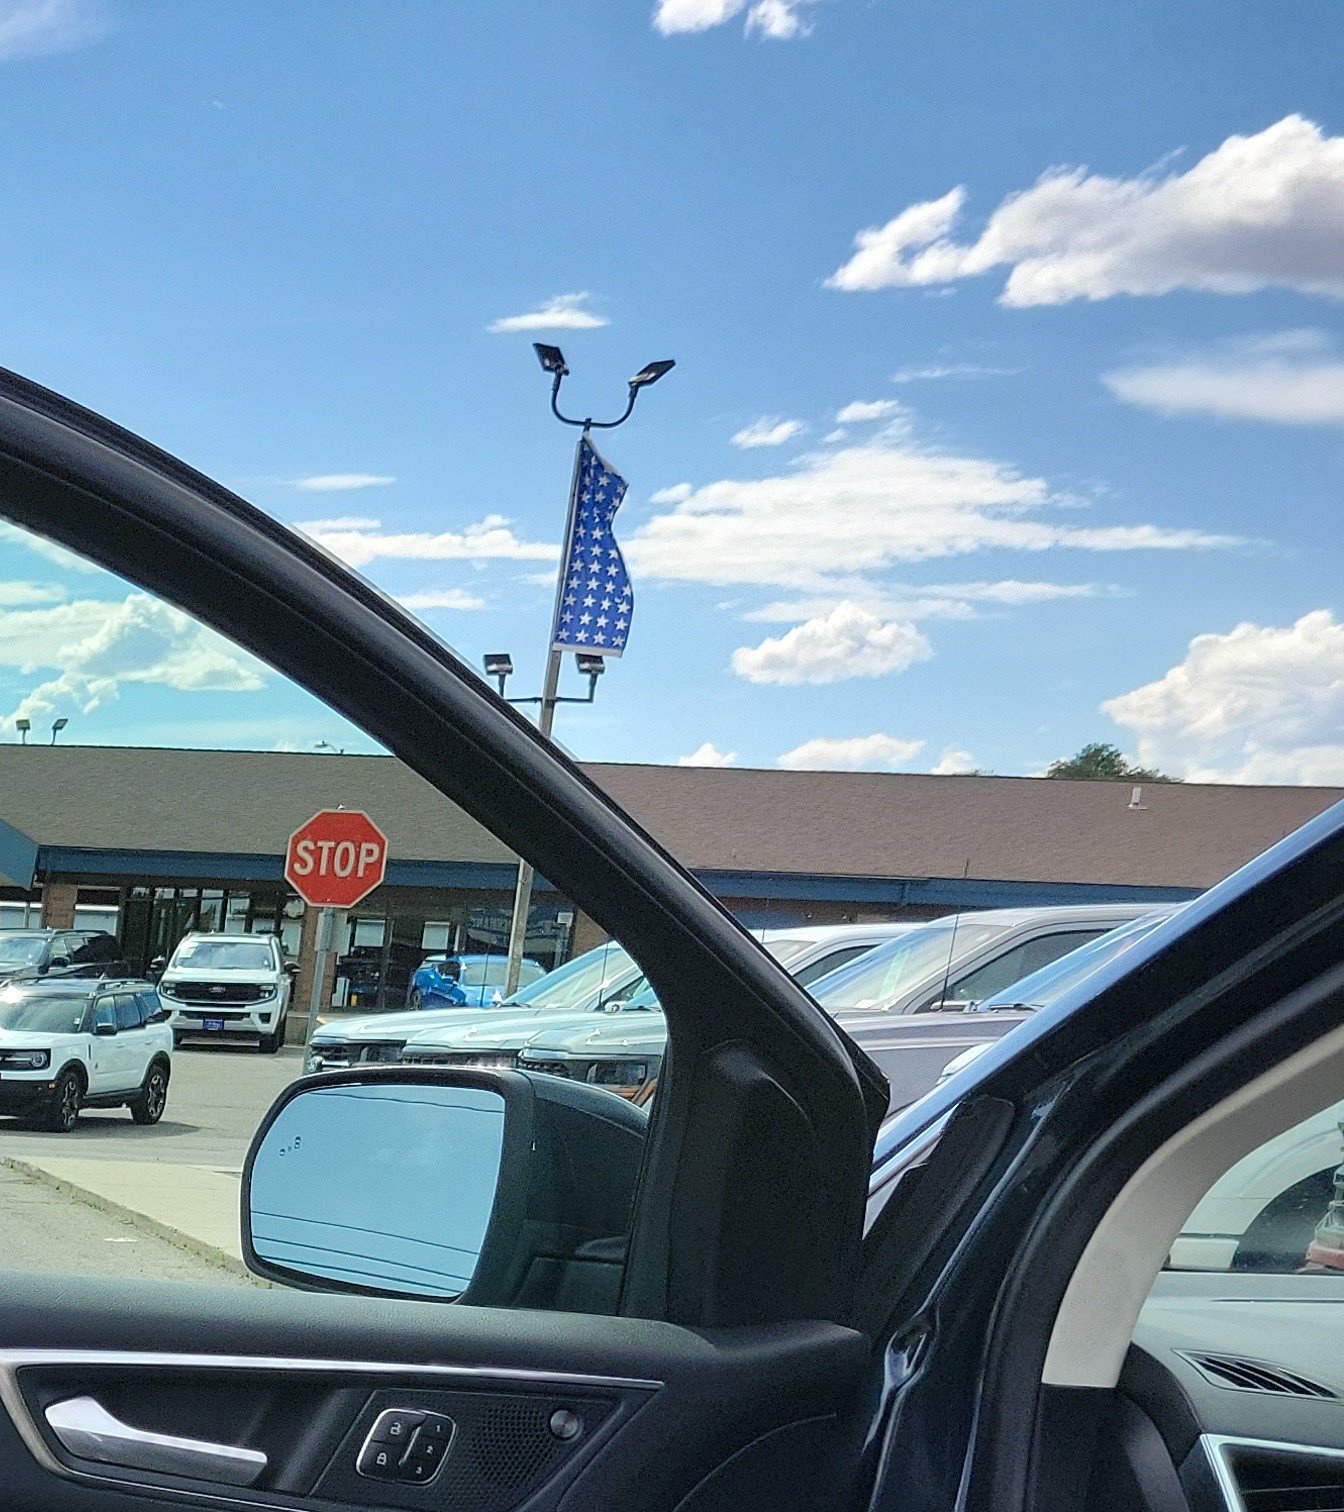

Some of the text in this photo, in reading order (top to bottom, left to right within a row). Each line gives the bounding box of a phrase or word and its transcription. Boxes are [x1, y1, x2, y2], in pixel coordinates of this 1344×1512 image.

[293, 840, 380, 878] STOP
[435, 1425, 441, 1433] 1
[426, 1446, 433, 1454] 2
[416, 1466, 422, 1474] 3
